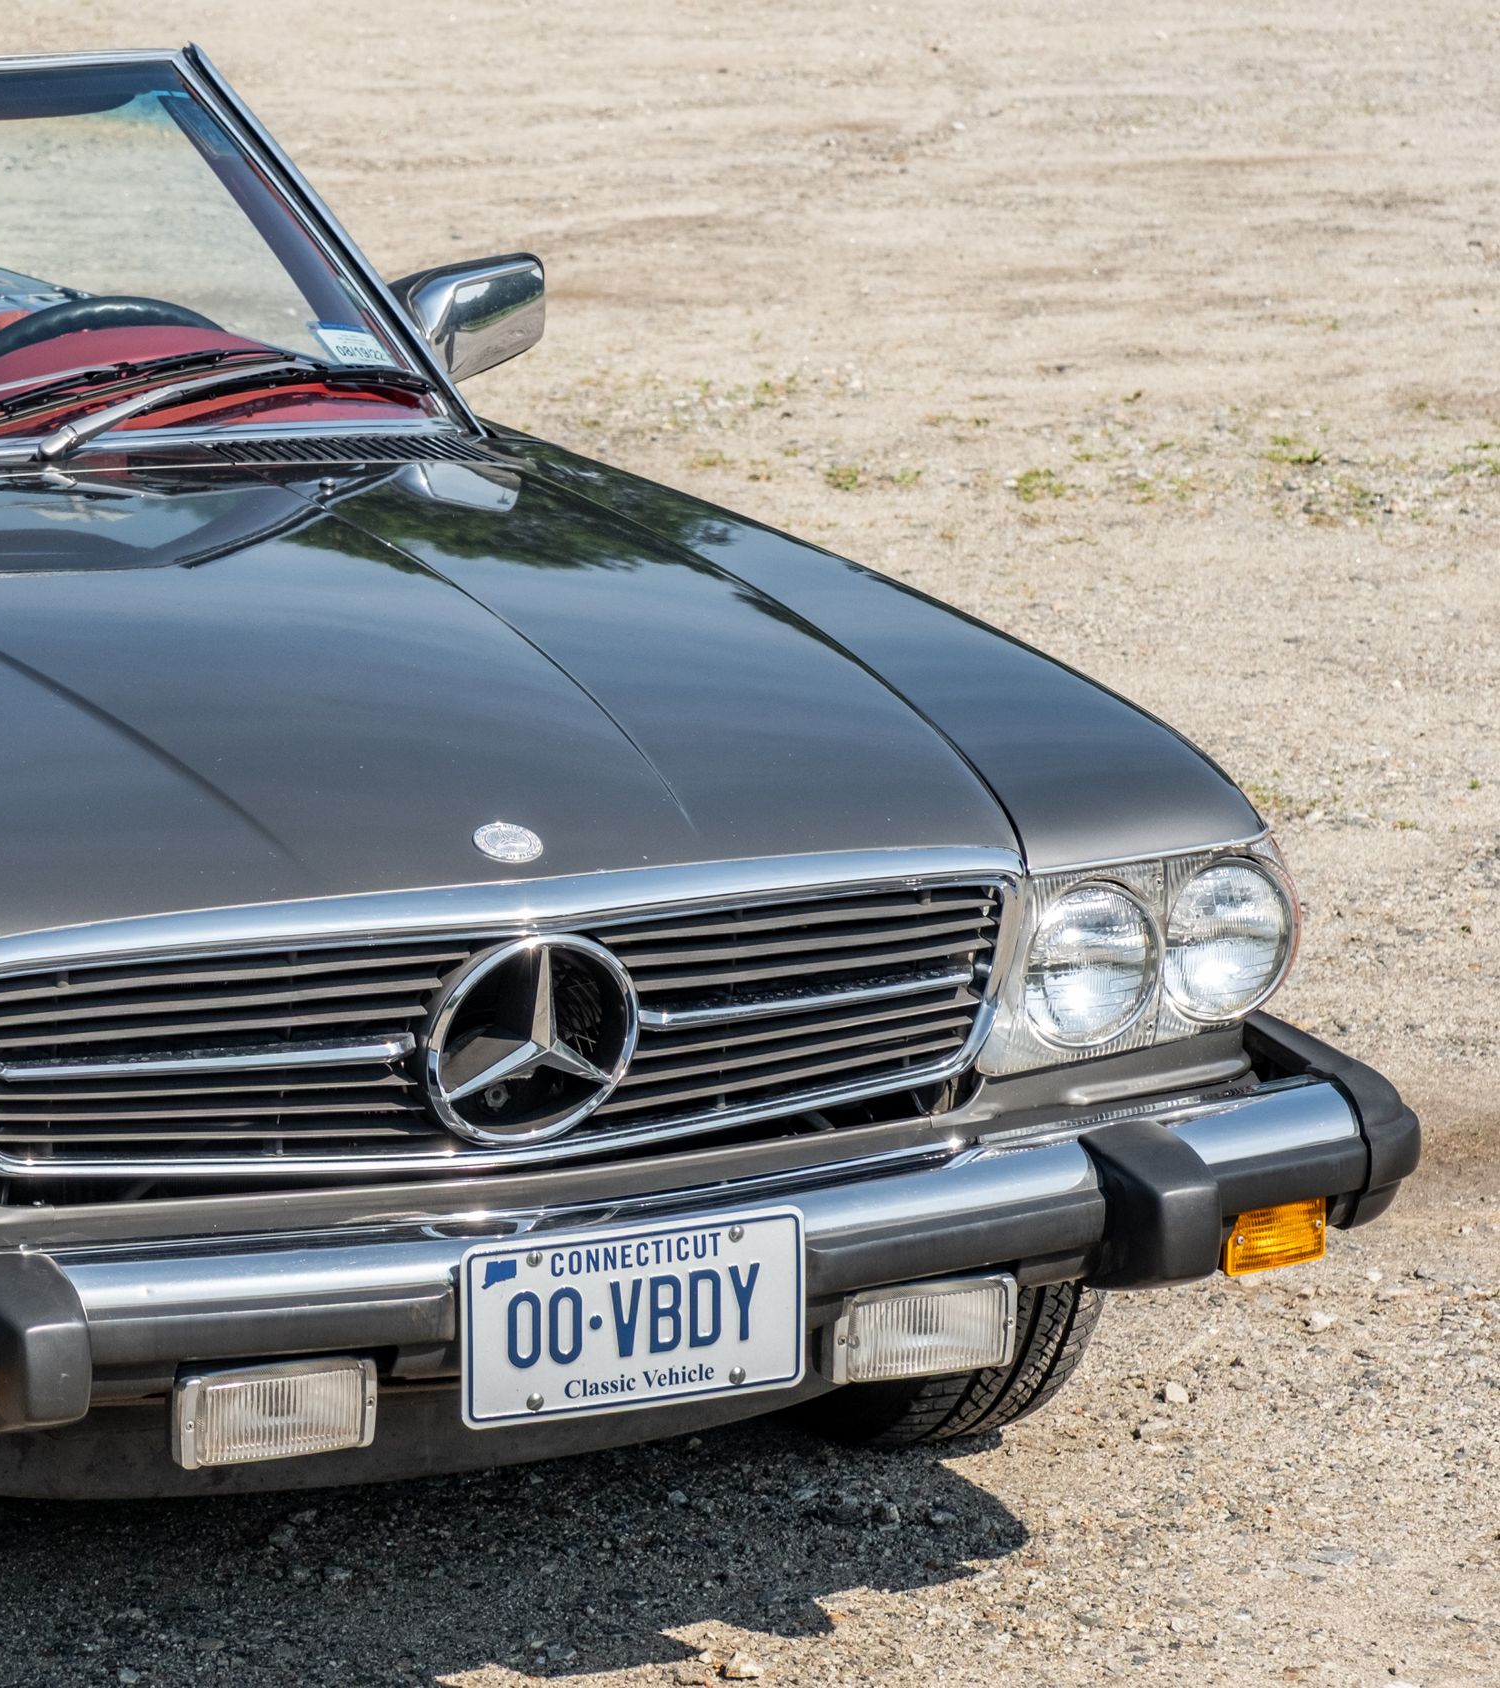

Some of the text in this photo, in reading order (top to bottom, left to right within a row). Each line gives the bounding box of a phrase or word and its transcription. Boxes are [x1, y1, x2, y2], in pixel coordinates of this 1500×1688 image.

[335, 345, 387, 361] 08/19/22
[551, 1232, 721, 1277] CONNECTICUT
[564, 1363, 715, 1400] Classic Vehicle
